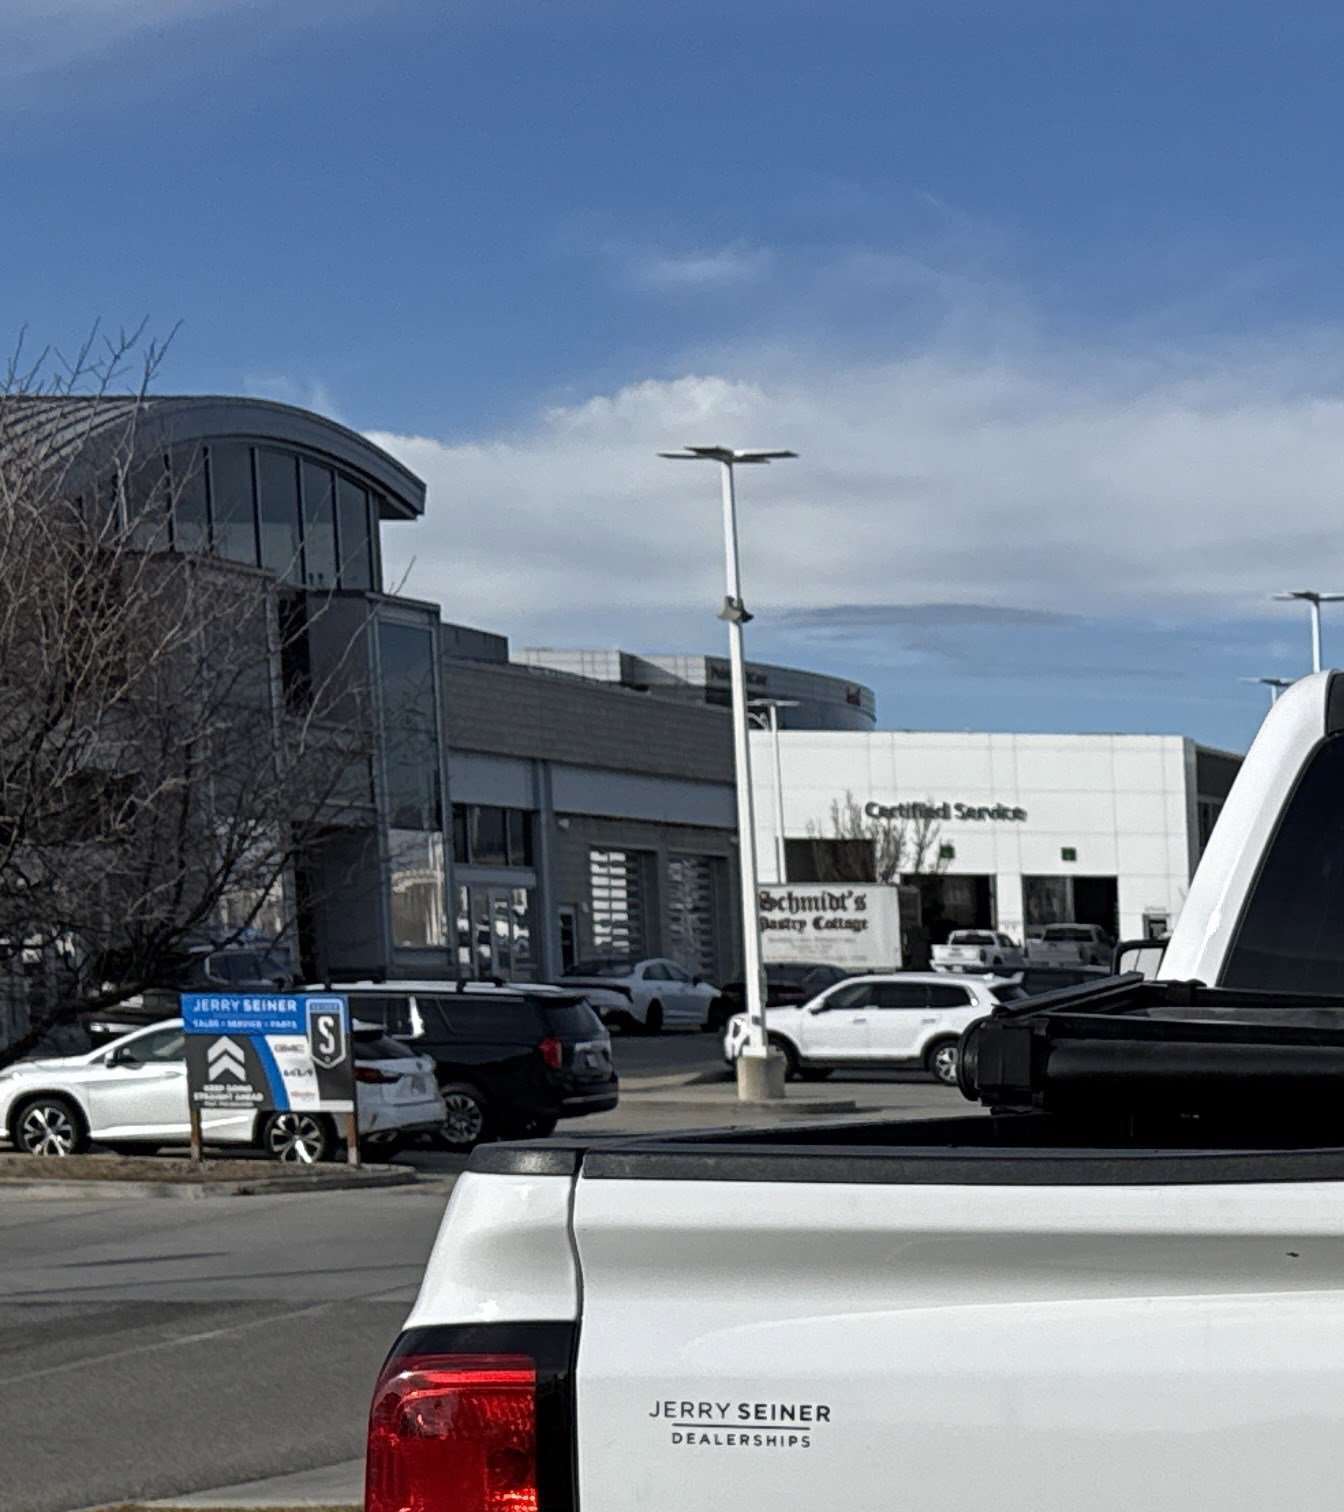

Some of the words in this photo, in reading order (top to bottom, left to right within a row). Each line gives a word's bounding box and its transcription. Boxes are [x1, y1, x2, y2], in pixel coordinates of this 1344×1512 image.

[865, 801, 951, 820] Certified
[954, 802, 1028, 822] Service
[759, 889, 867, 914] Schmidt's
[193, 999, 240, 1012] JERRY
[243, 999, 297, 1012] SEINER
[649, 1400, 731, 1420] JERRY
[738, 1402, 831, 1423] SEINER
[671, 1432, 811, 1449] DEALERSHIPS
